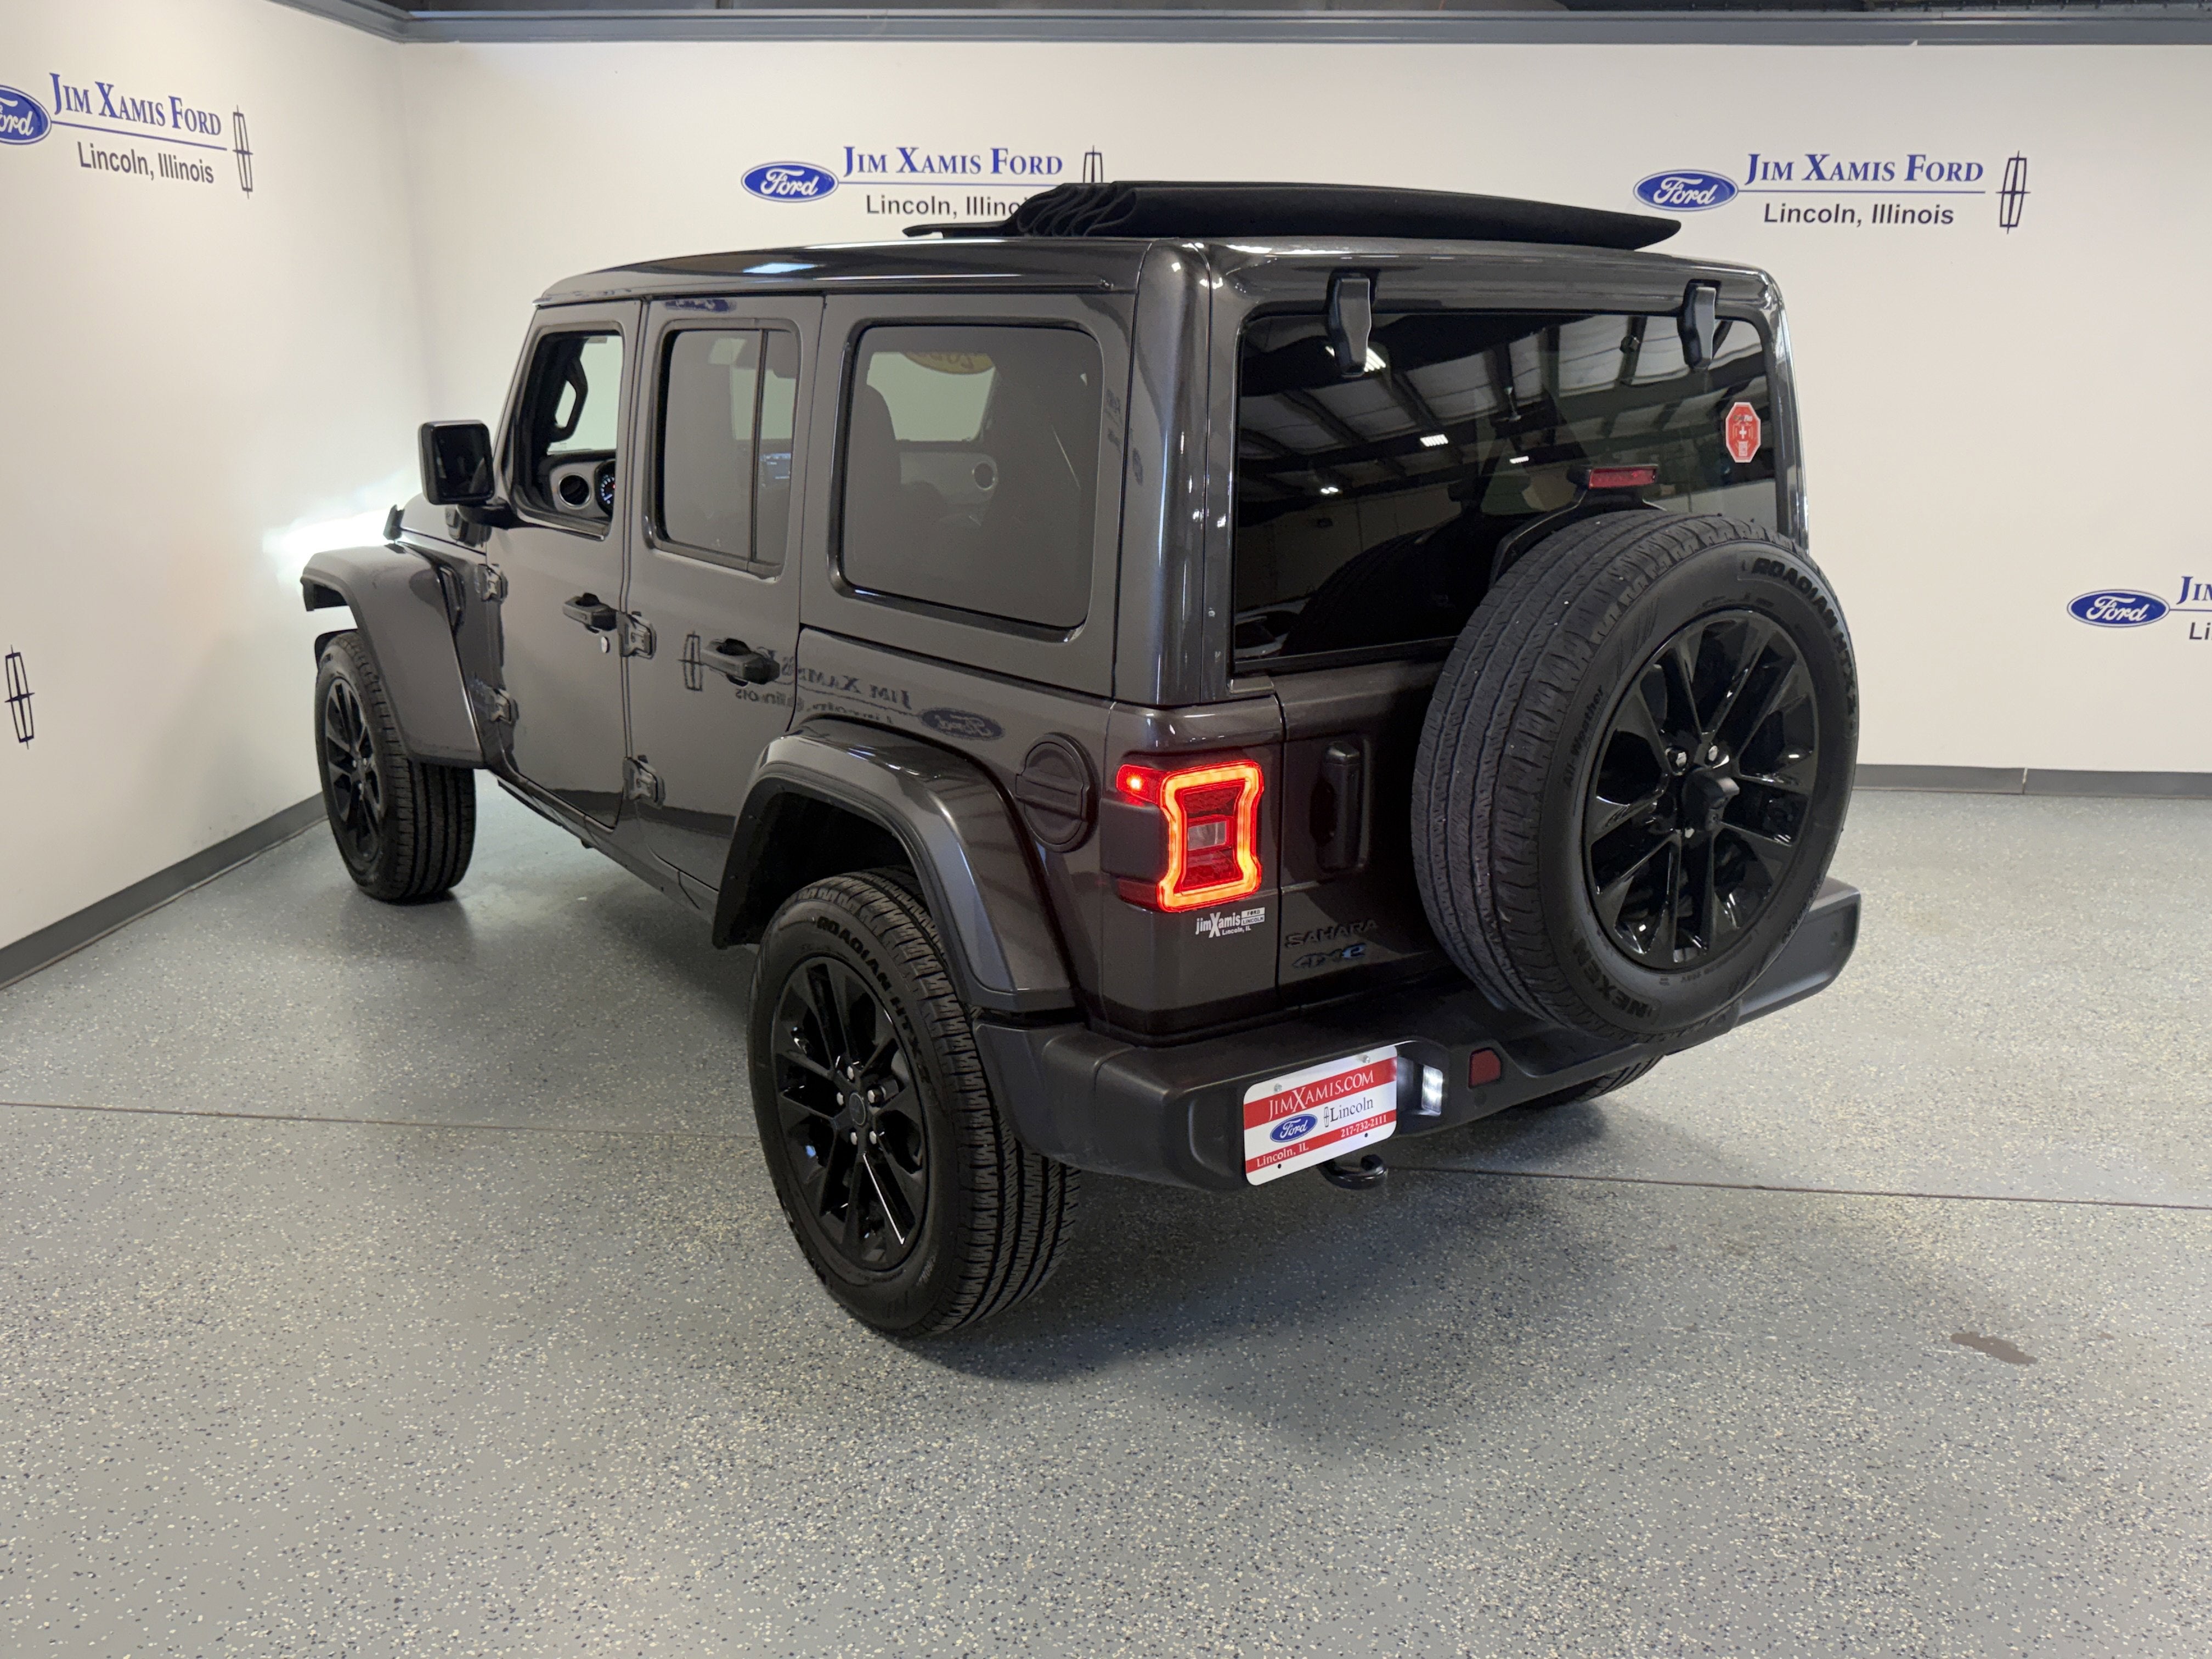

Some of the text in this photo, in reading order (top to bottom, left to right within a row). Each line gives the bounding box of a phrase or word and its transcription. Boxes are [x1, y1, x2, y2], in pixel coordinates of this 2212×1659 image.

[95, 81, 166, 126] XAMIS
[77, 142, 214, 183] Lincoln, Illinois
[896, 147, 982, 176] XAMIS
[1802, 154, 1895, 182] XAMIS
[760, 168, 818, 196] Ford
[1653, 176, 1719, 206] Ford
[866, 195, 1028, 219] Lincoln, Illino
[1764, 203, 1954, 227] Lincoln, Illinois
[2086, 595, 2149, 622] Ford
[1285, 919, 1379, 948] SAHARA
[1330, 1097, 1374, 1122] Lincoln
[1280, 1119, 1307, 1139] Ford
[1341, 1115, 1387, 1138] 217-732-2111
[1256, 1143, 1309, 1167] Lincoln, IL
